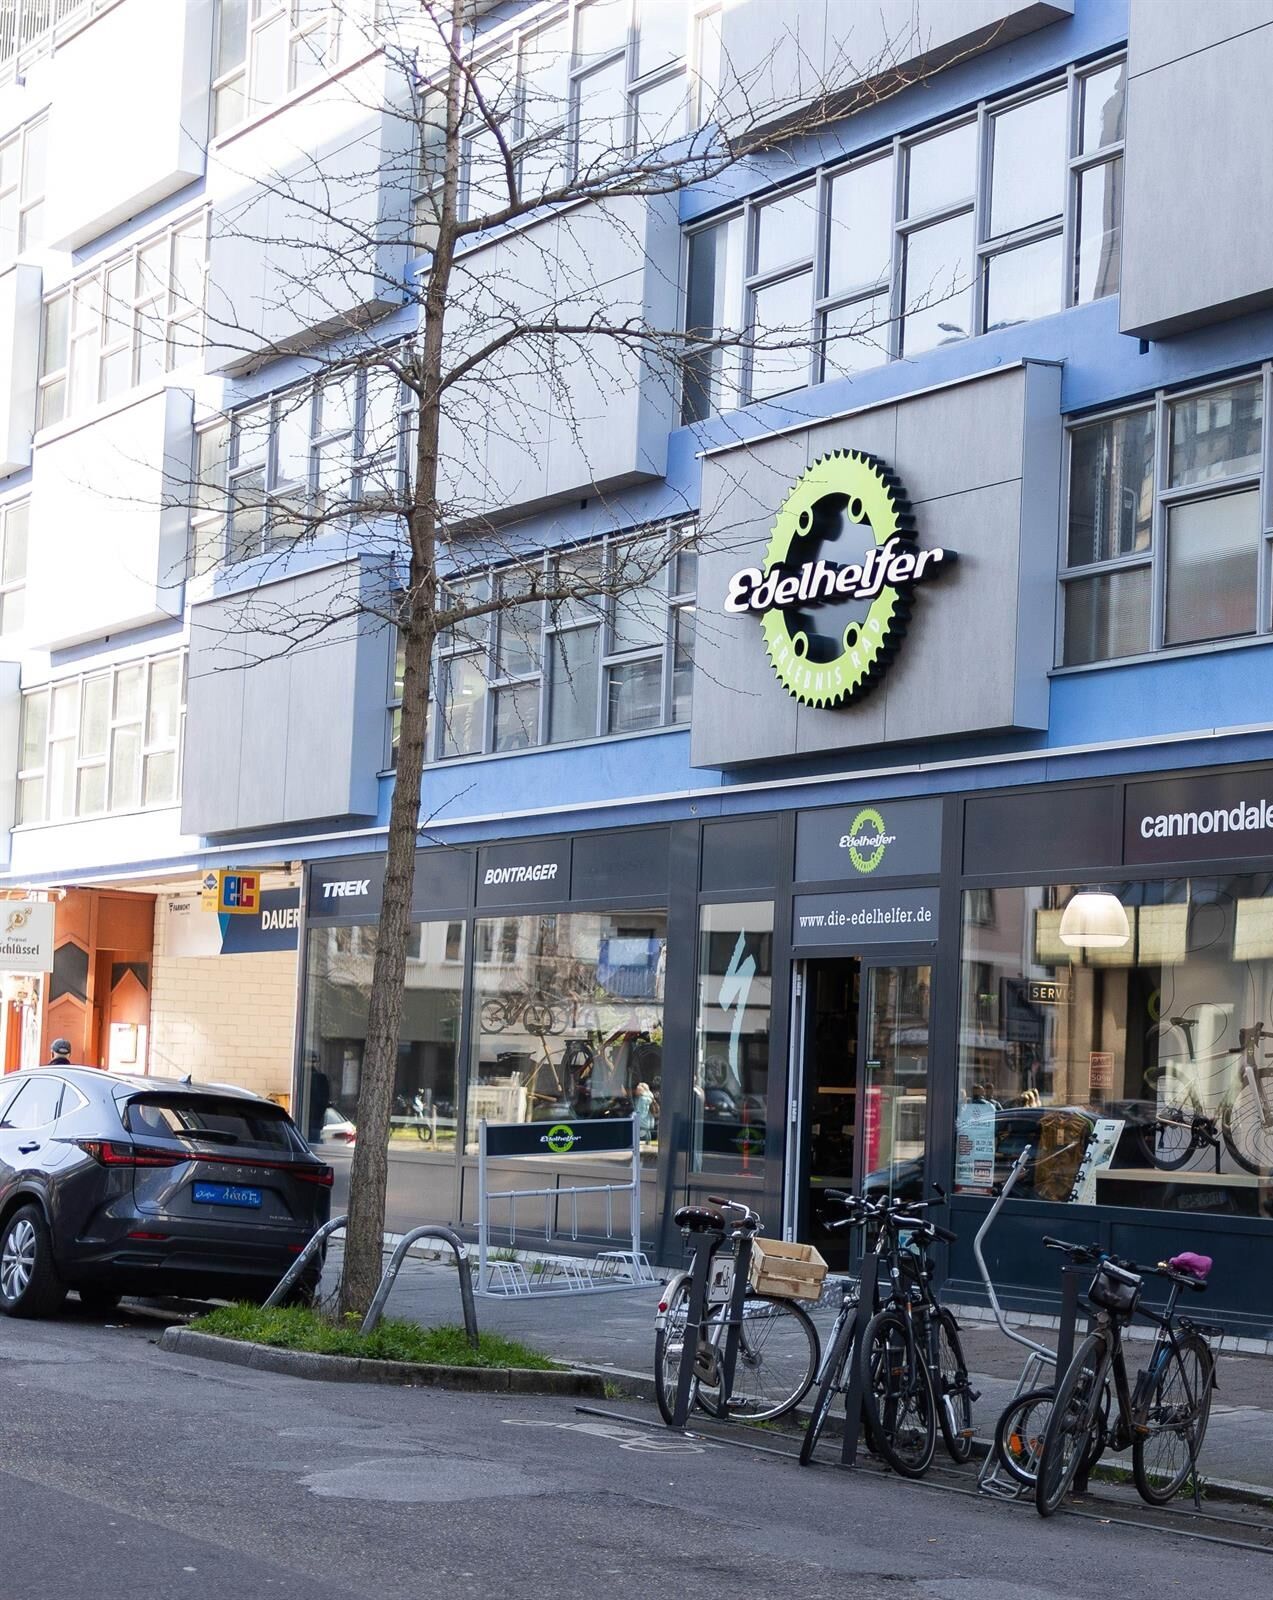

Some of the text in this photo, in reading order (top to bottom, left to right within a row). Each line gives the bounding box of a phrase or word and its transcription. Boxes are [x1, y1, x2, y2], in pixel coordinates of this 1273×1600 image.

[723, 537, 944, 613] Edelhelfer
[773, 617, 881, 691] ERLEBNIS RAD
[839, 832, 896, 848] Edelhelfer
[484, 863, 558, 885] BONTRAGER
[322, 879, 371, 898] TREK
[799, 906, 932, 928] www.die-edelhelfer.de
[0, 943, 40, 955] chlüssel
[207, 1164, 271, 1176] LEXUS
